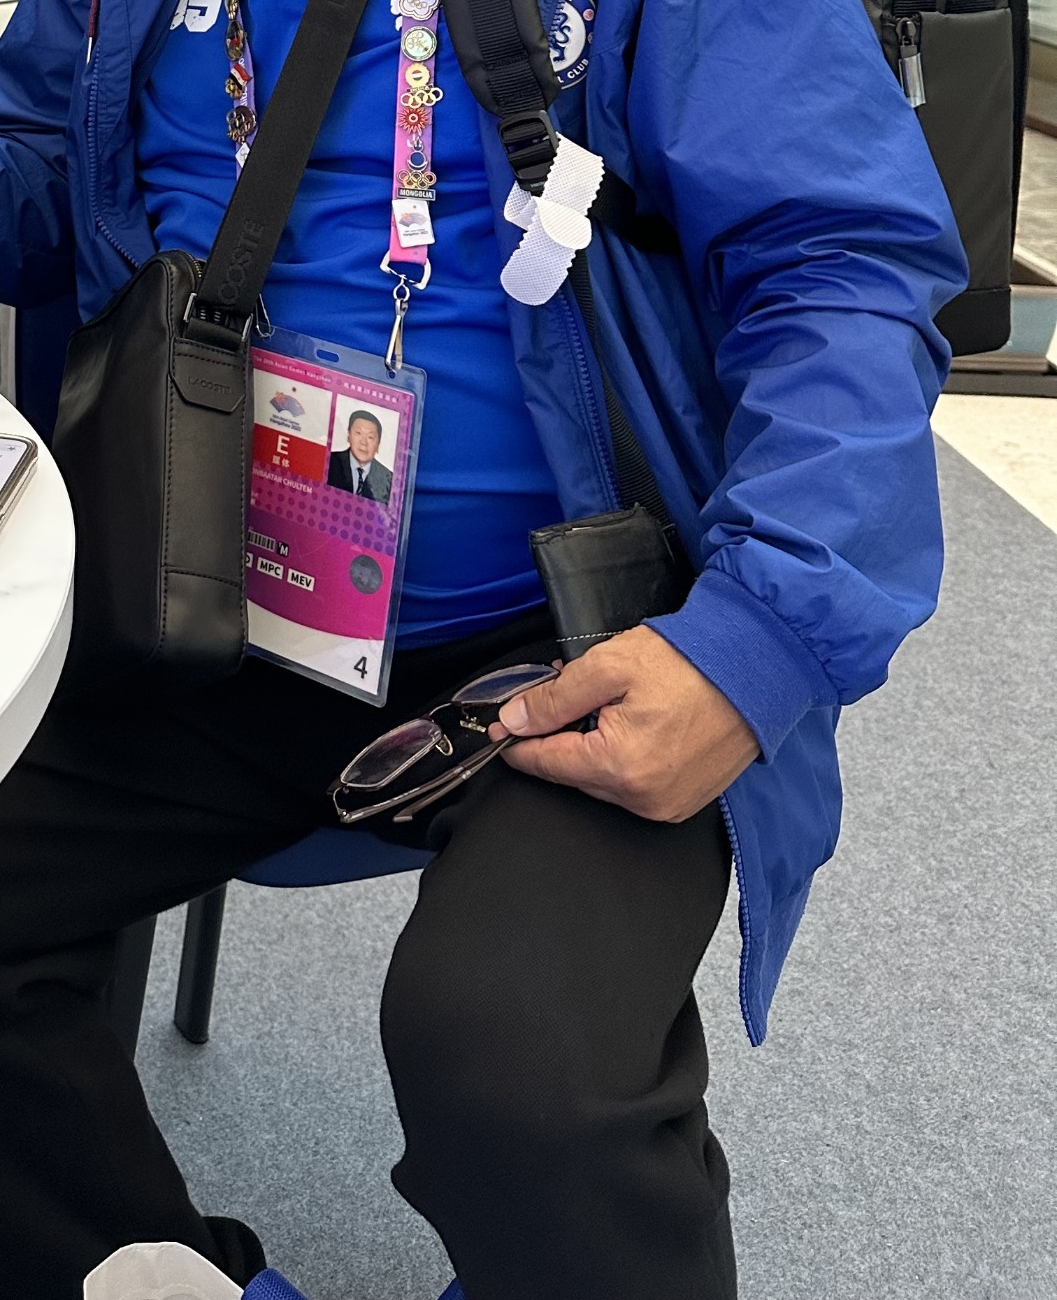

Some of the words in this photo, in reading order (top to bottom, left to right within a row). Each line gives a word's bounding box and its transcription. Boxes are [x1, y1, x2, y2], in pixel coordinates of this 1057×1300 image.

[567, 58, 589, 79] CLUB
[399, 189, 433, 199] MONGOLIA
[276, 434, 291, 455] E
[282, 478, 313, 494] CHULTEM
[260, 557, 281, 576] MPC
[290, 572, 313, 588] MEV
[353, 656, 368, 679] 4
